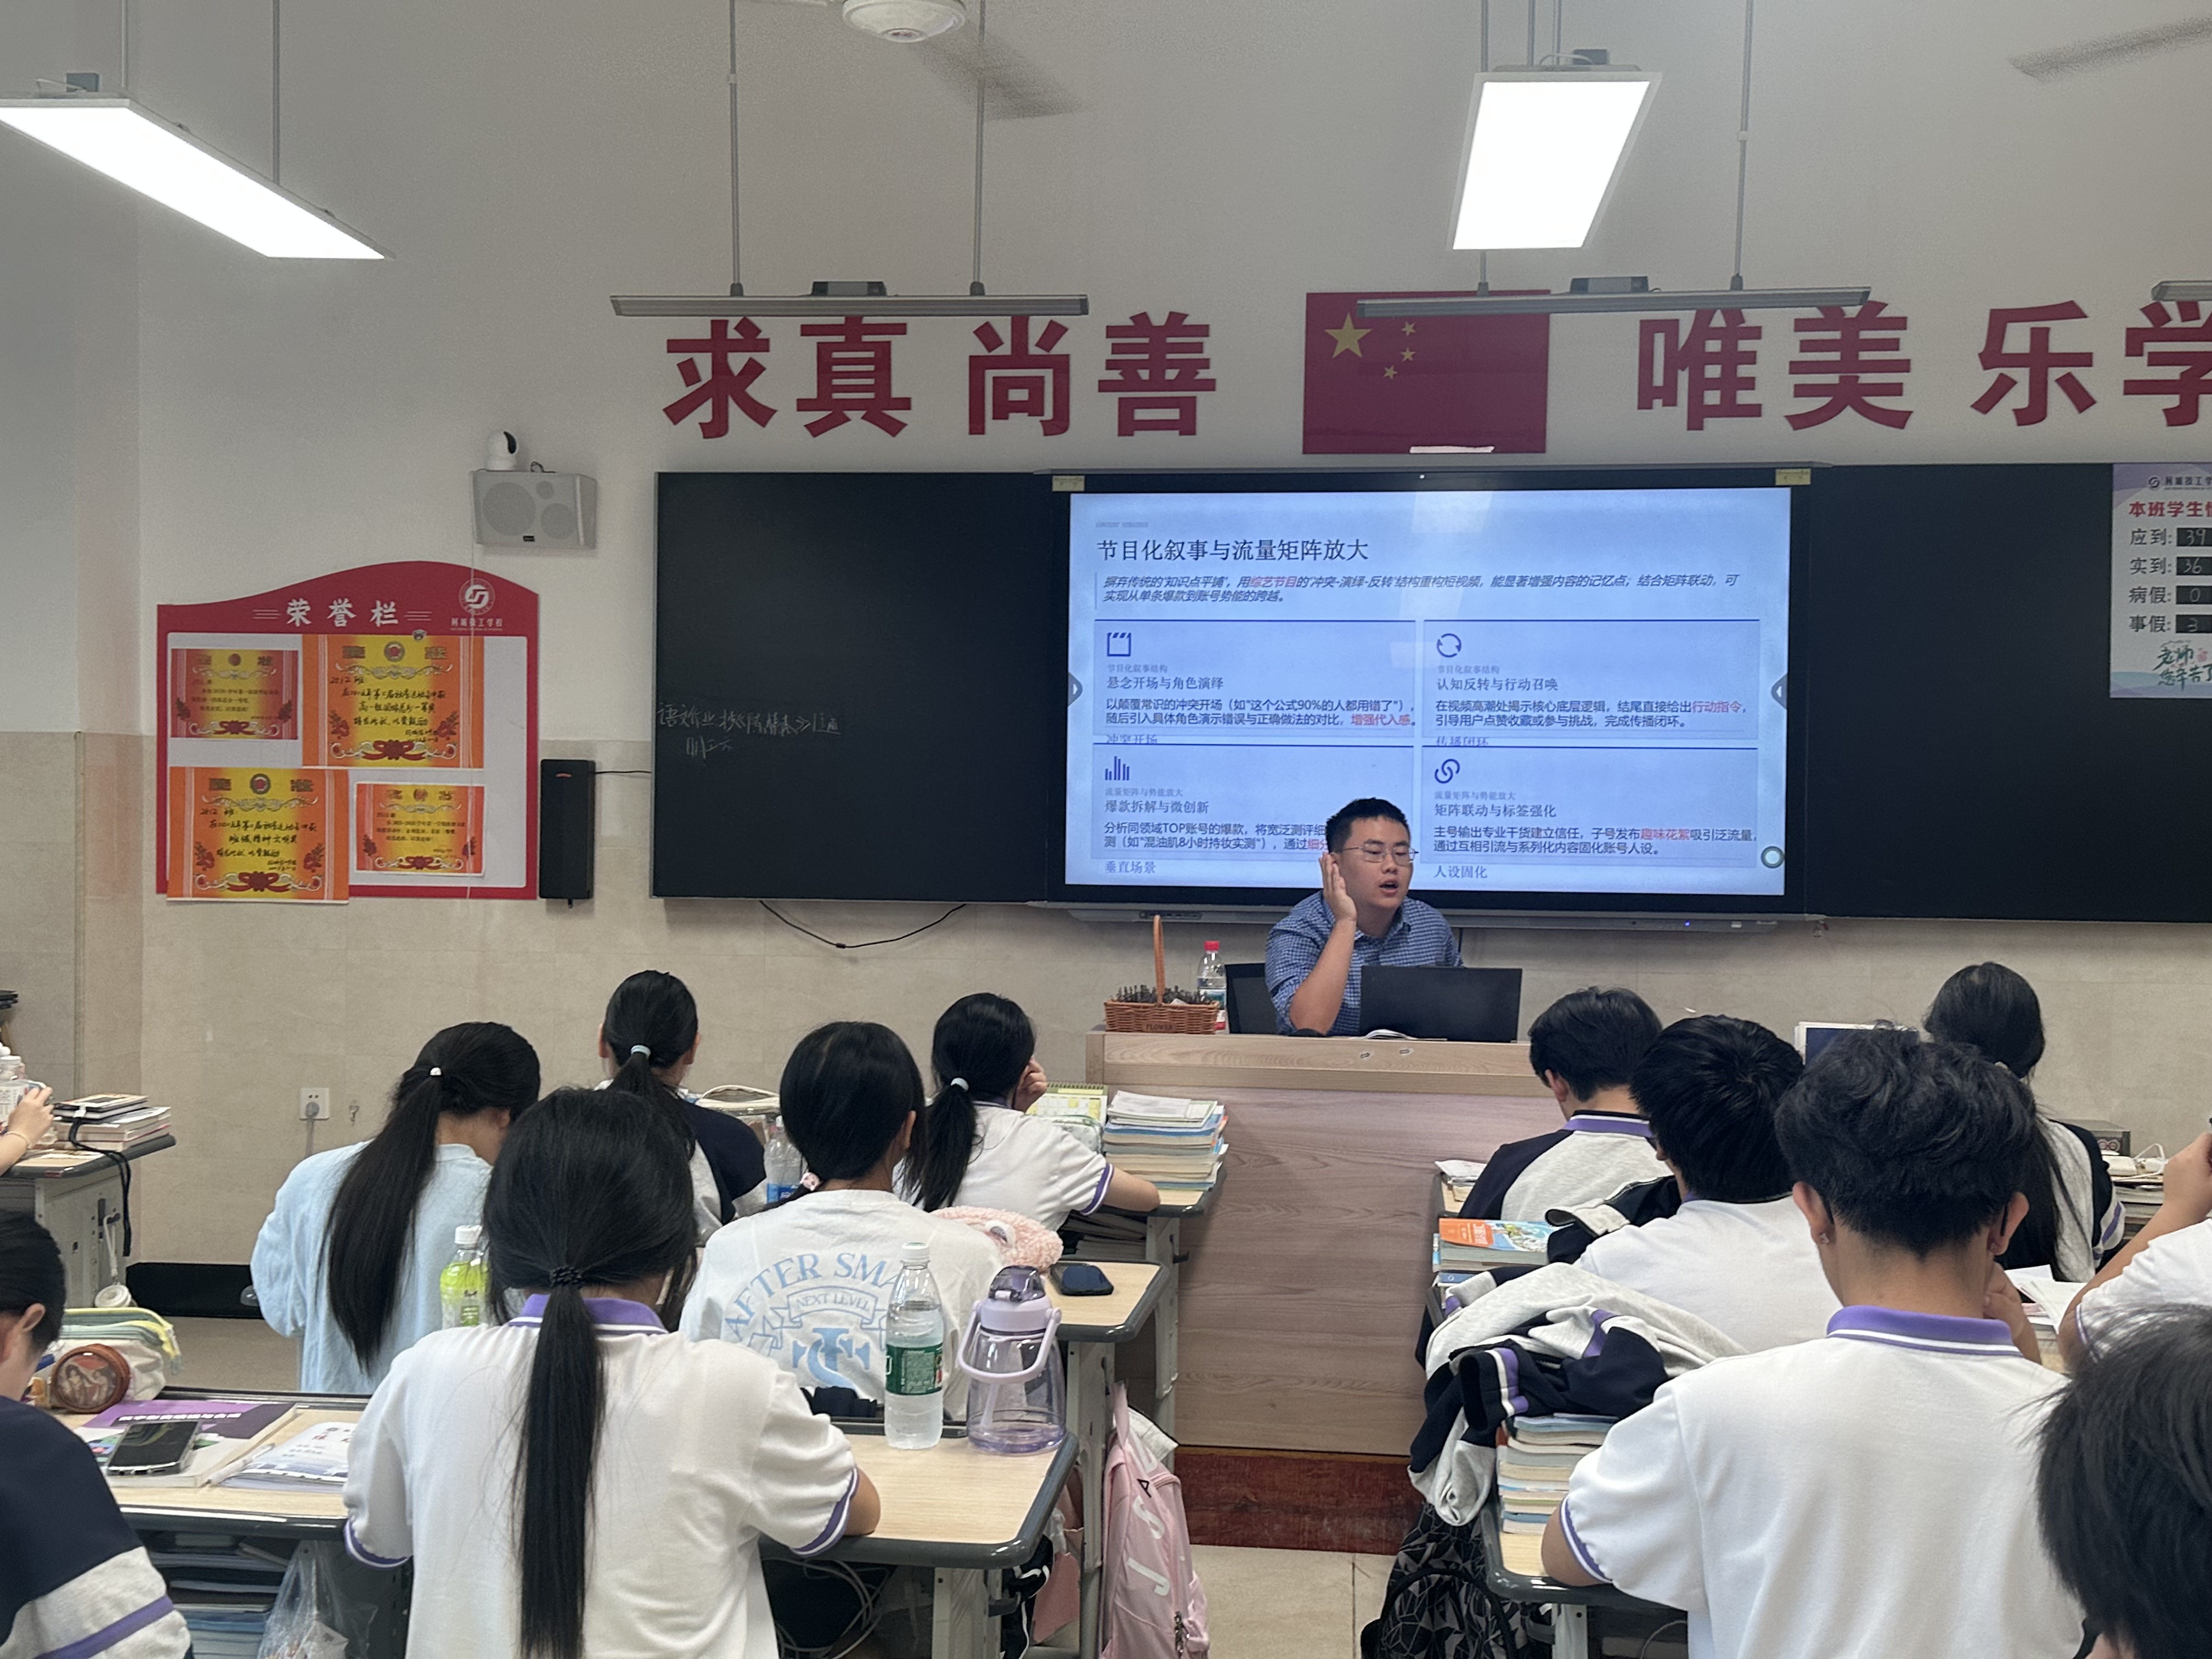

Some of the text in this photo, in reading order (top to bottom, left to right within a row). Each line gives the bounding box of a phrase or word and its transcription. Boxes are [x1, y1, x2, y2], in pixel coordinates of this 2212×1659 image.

[1637, 300, 2212, 431] 唯美 乐学
[662, 311, 1216, 439] 求真 尚善
[1097, 539, 1369, 561] 节目化叙事与流量矩阵放大
[286, 598, 400, 628] 荣誉栏
[1107, 676, 1224, 690] 悬念开场与角色演绎
[1437, 678, 1559, 691] 认知反转与行动召唤
[1105, 800, 1209, 814] 爆款拆解与微创新
[1434, 803, 1557, 817] 矩阵联动与标签强化
[1105, 861, 1156, 874] 垂直场景
[1434, 865, 1488, 878] 人设固化
[725, 1253, 822, 1342] AFTER
[795, 1291, 870, 1312] NEXT LEVEL
